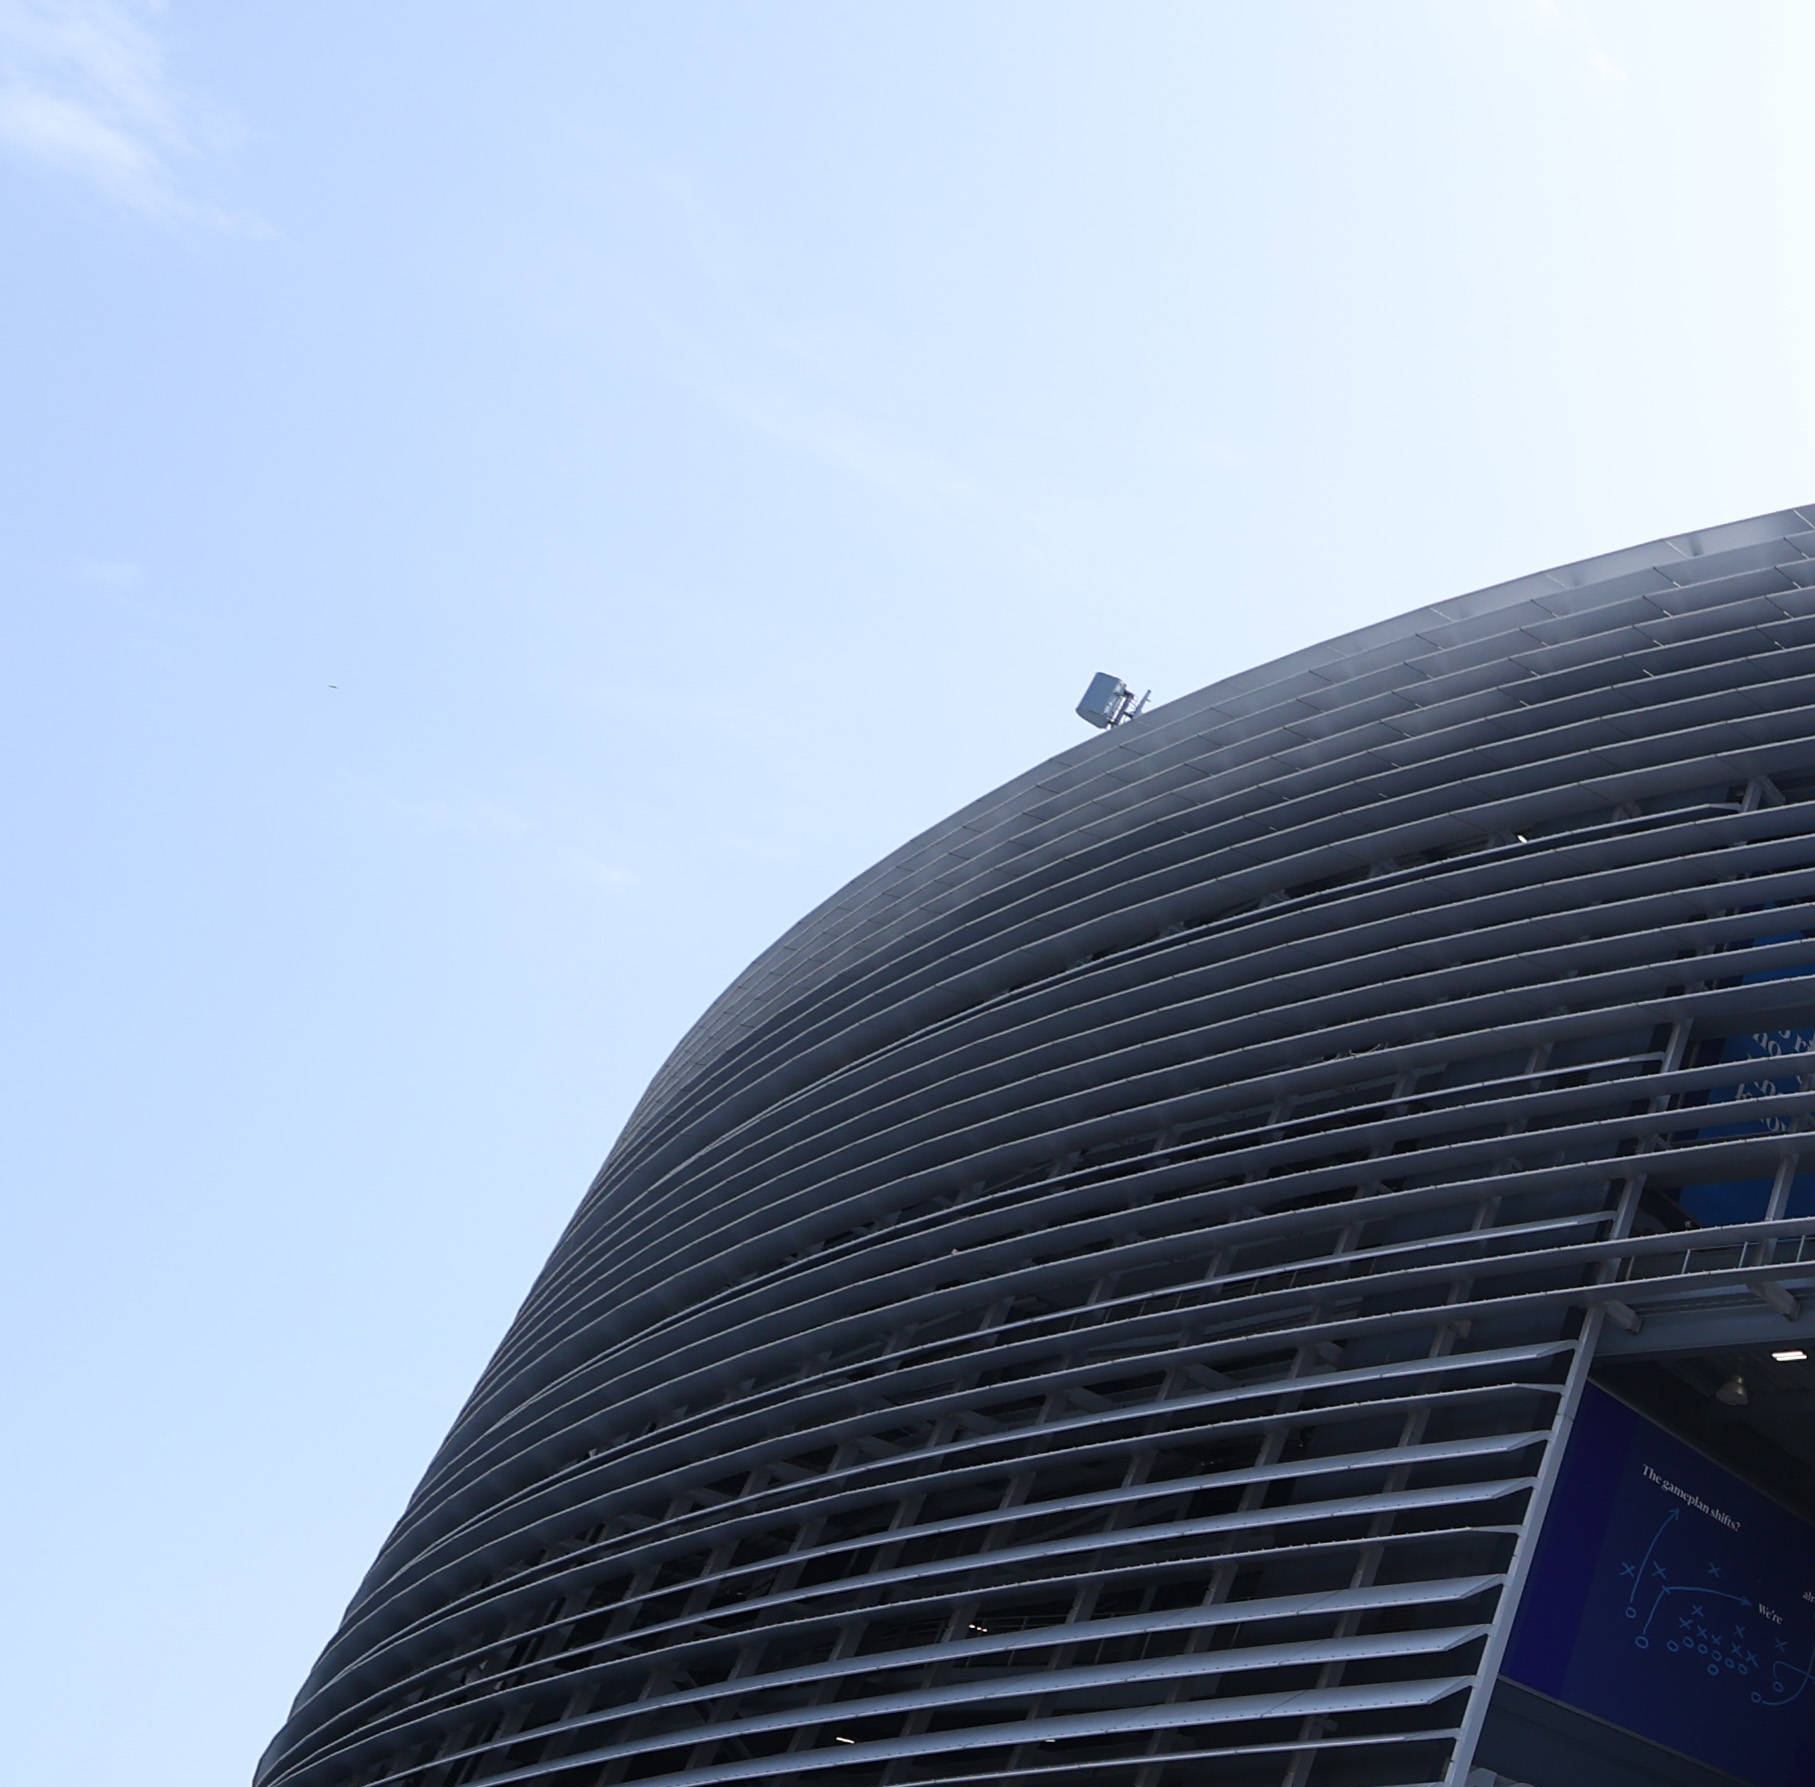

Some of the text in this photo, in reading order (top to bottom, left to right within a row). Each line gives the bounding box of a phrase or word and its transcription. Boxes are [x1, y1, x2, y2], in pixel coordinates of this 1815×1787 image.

[1641, 1463, 1741, 1532] The gameplan shifts?
[1758, 1603, 1783, 1625] We're
